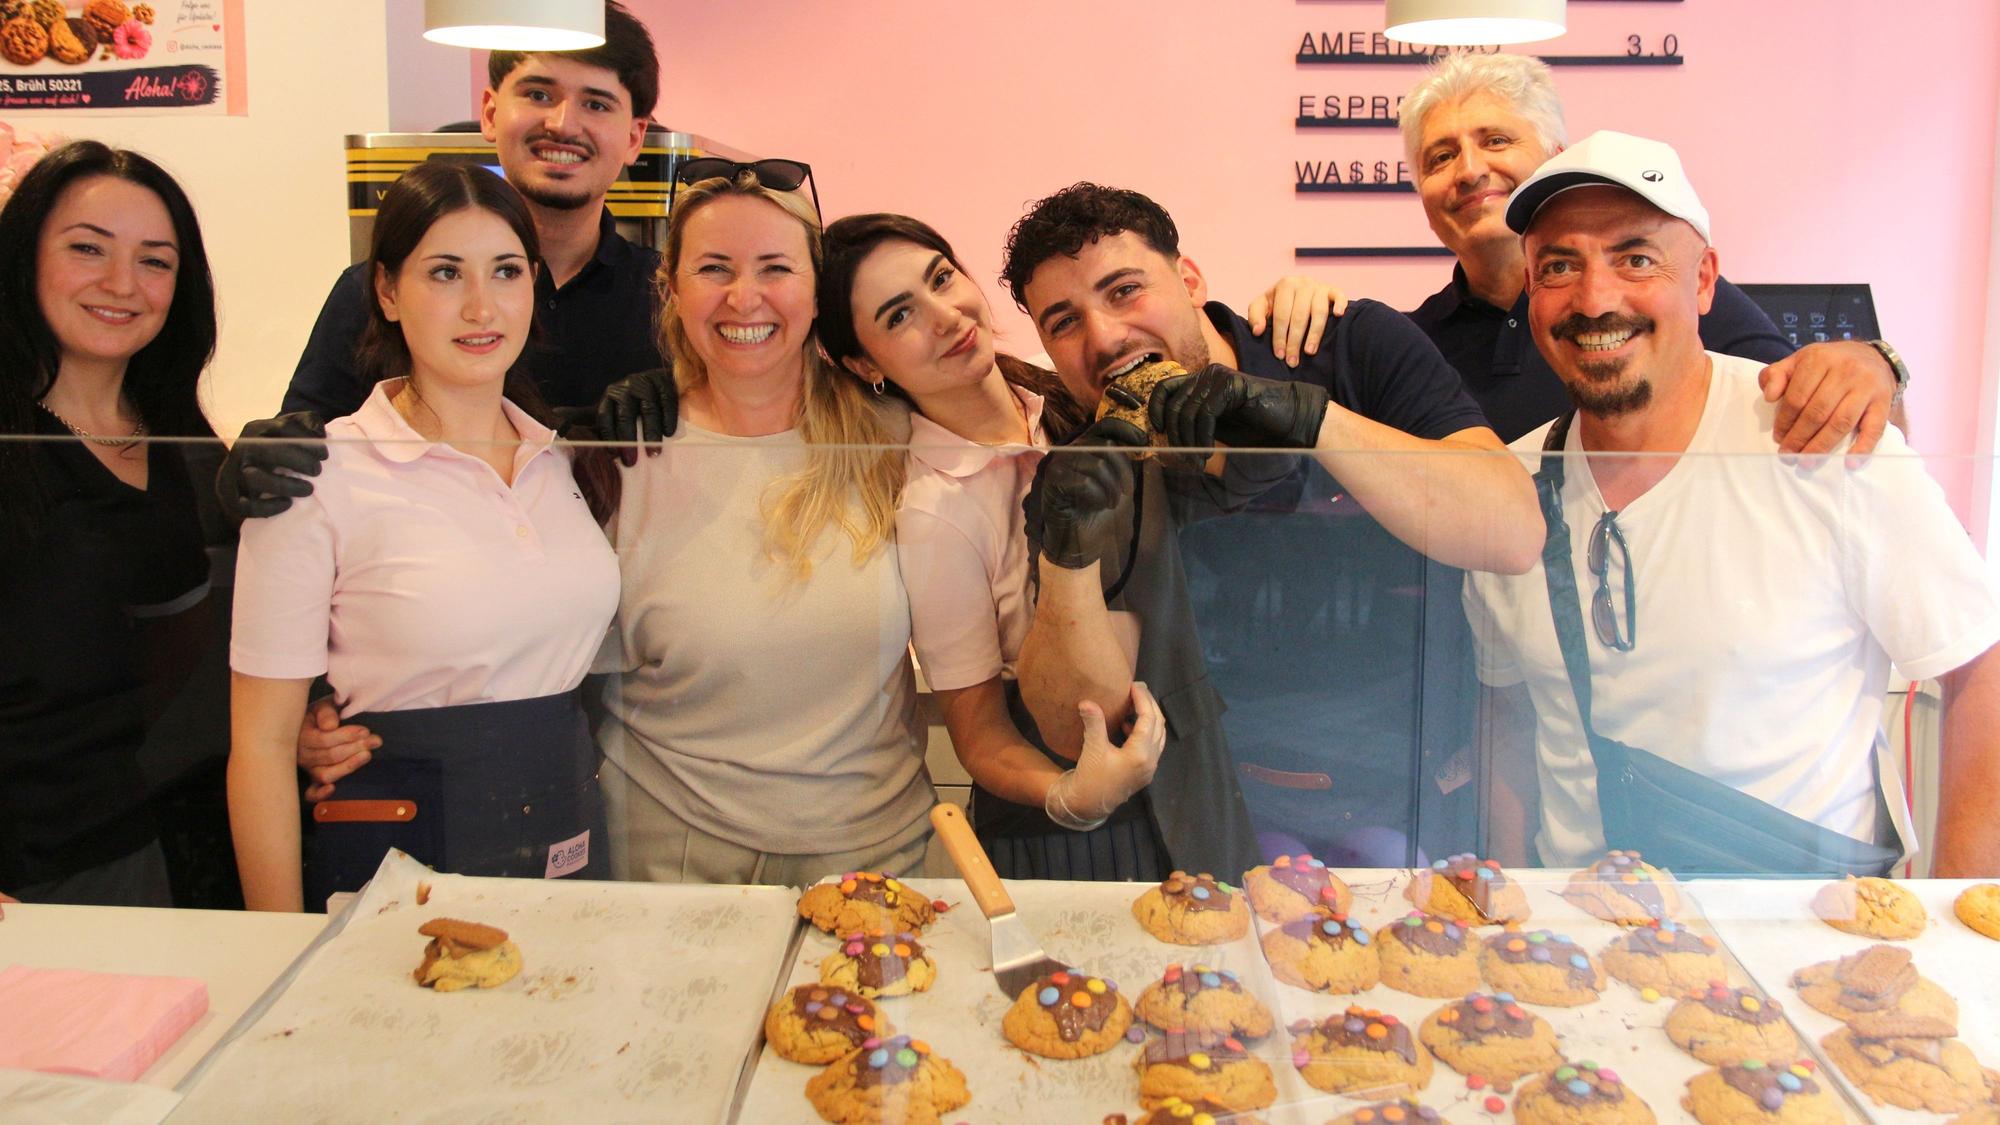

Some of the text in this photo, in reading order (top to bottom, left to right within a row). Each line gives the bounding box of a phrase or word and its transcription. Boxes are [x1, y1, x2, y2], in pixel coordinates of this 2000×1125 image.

[1627, 33, 1678, 57] 3.0
[16, 79, 48, 92] Brühl
[48, 79, 82, 92] 50321
[124, 76, 178, 101] Aloha!
